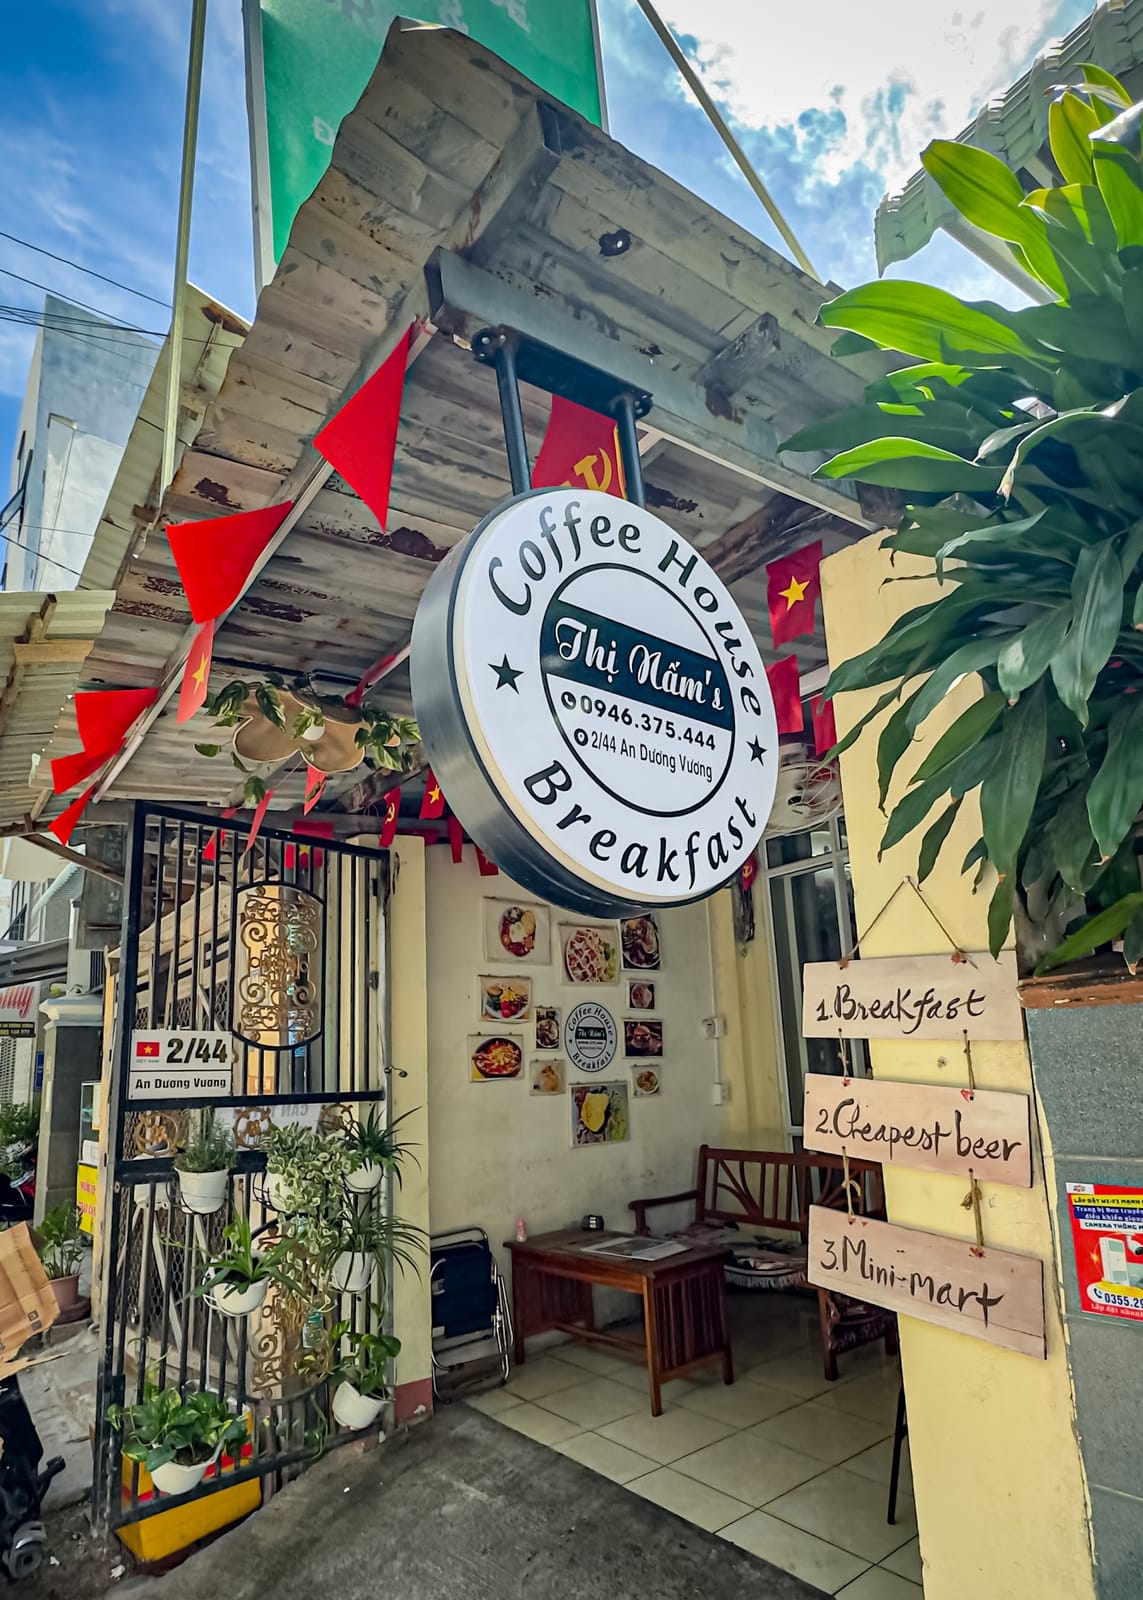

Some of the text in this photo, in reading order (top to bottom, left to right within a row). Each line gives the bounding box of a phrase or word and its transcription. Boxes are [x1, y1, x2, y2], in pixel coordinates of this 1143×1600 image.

[488, 501, 763, 717] Coffee House
[555, 616, 619, 683] Thị
[580, 694, 716, 751] 0946.375.444
[591, 730, 712, 783] 2/44 An Dương Vương
[524, 759, 758, 889] Breakfast
[568, 1007, 613, 1036] Coffee House
[166, 1037, 228, 1064] 2/44
[573, 1051, 611, 1070] Breakfast
[135, 1079, 151, 1089] An
[954, 1109, 1022, 1161] beer
